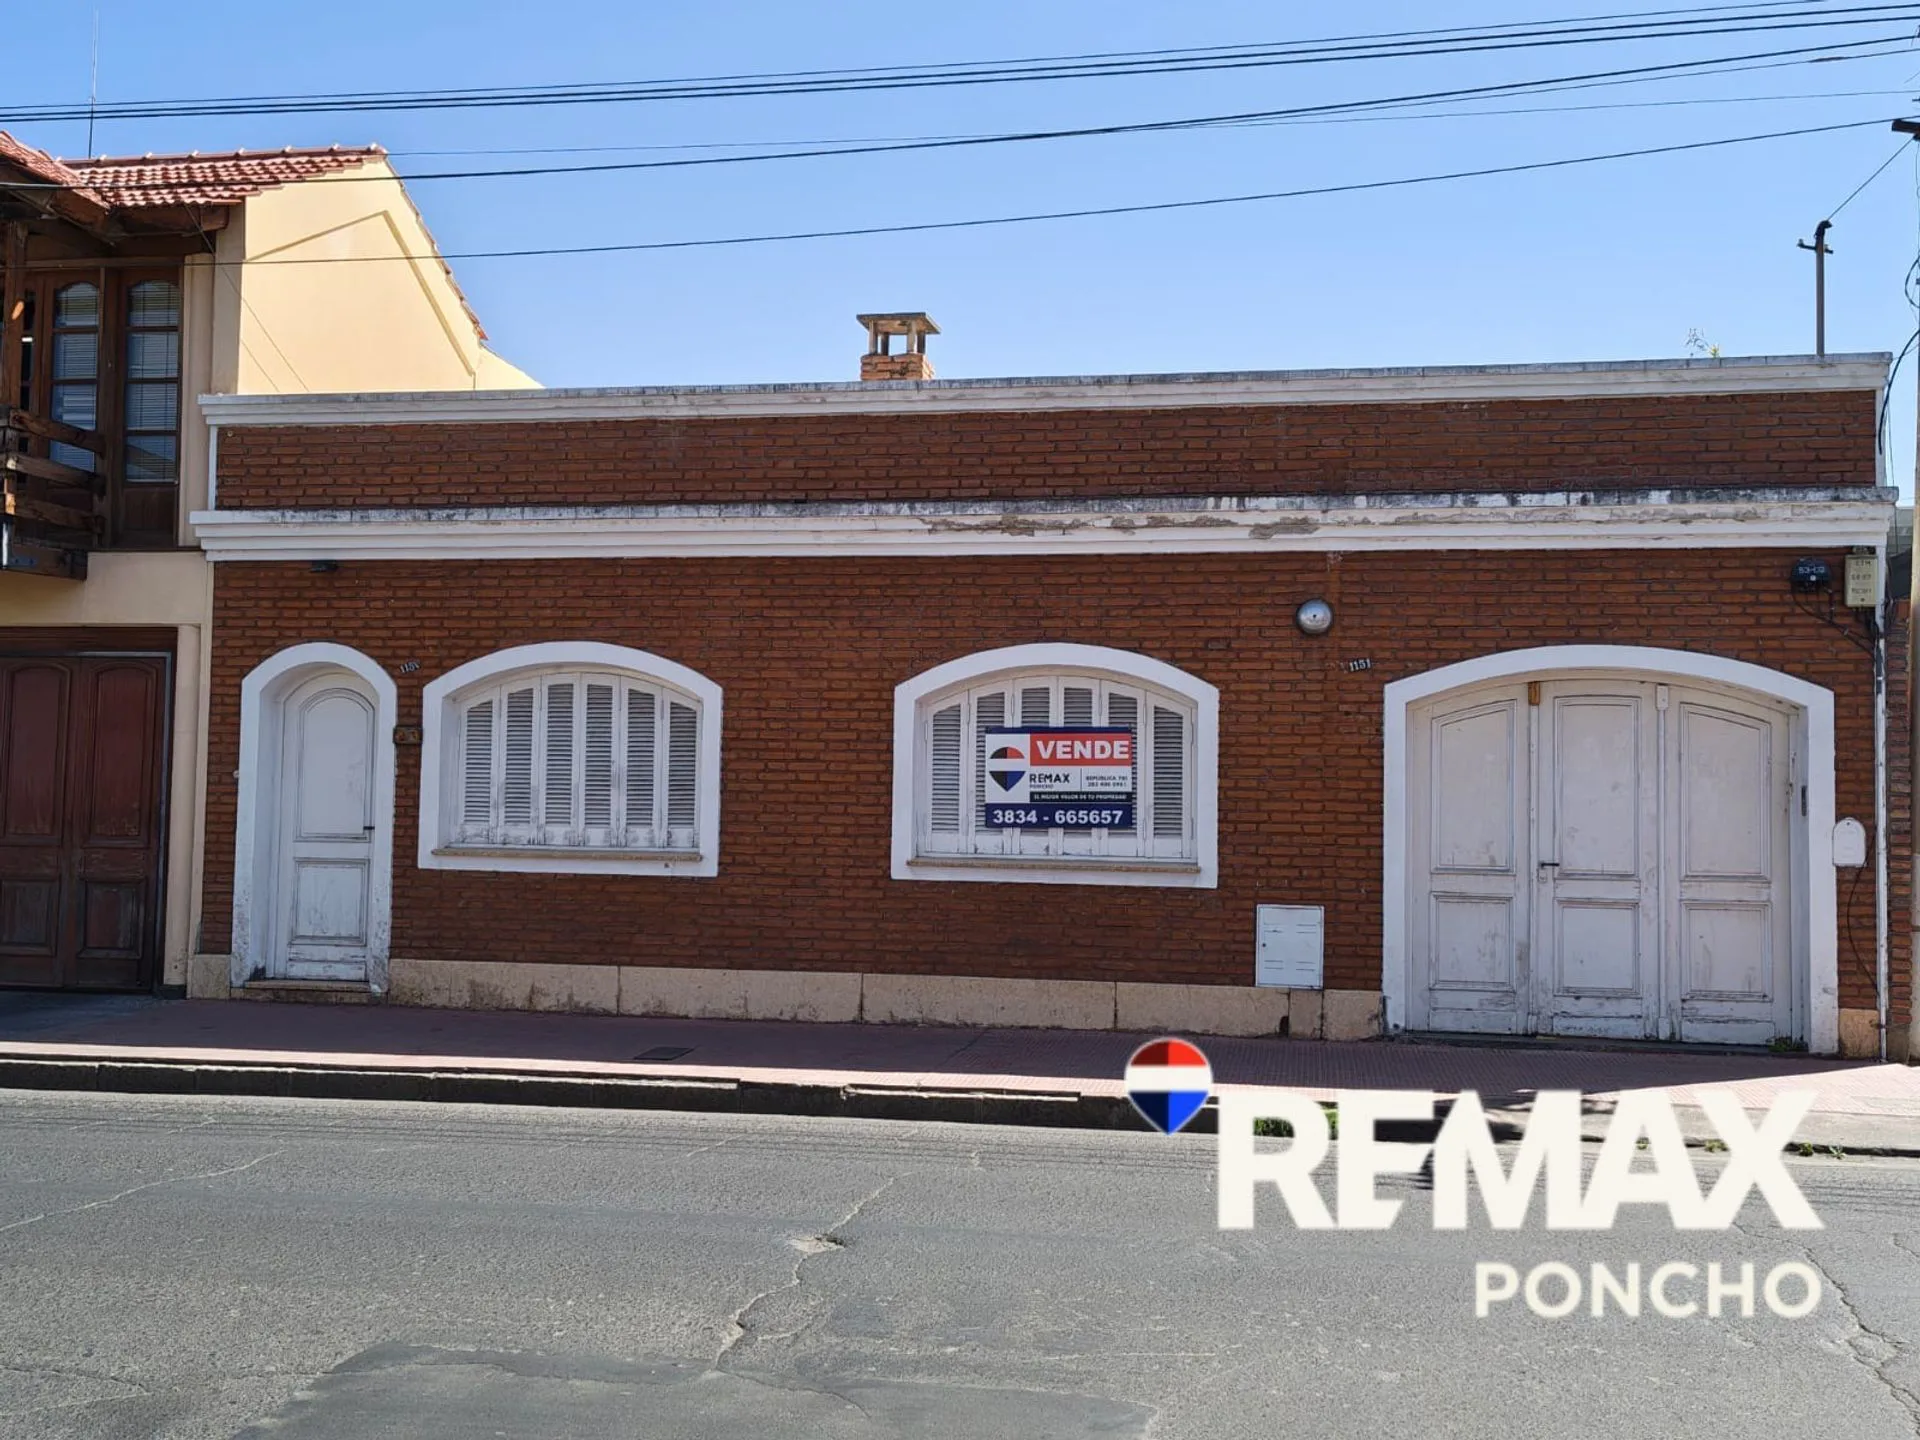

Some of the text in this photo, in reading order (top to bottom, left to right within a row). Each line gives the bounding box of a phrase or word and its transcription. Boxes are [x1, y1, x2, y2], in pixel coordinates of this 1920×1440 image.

[1349, 658, 1371, 671] 1151
[1036, 740, 1129, 759] VENDE
[1029, 773, 1070, 783] REMAX
[993, 810, 1038, 824] 3834
[1054, 810, 1123, 824] 665657
